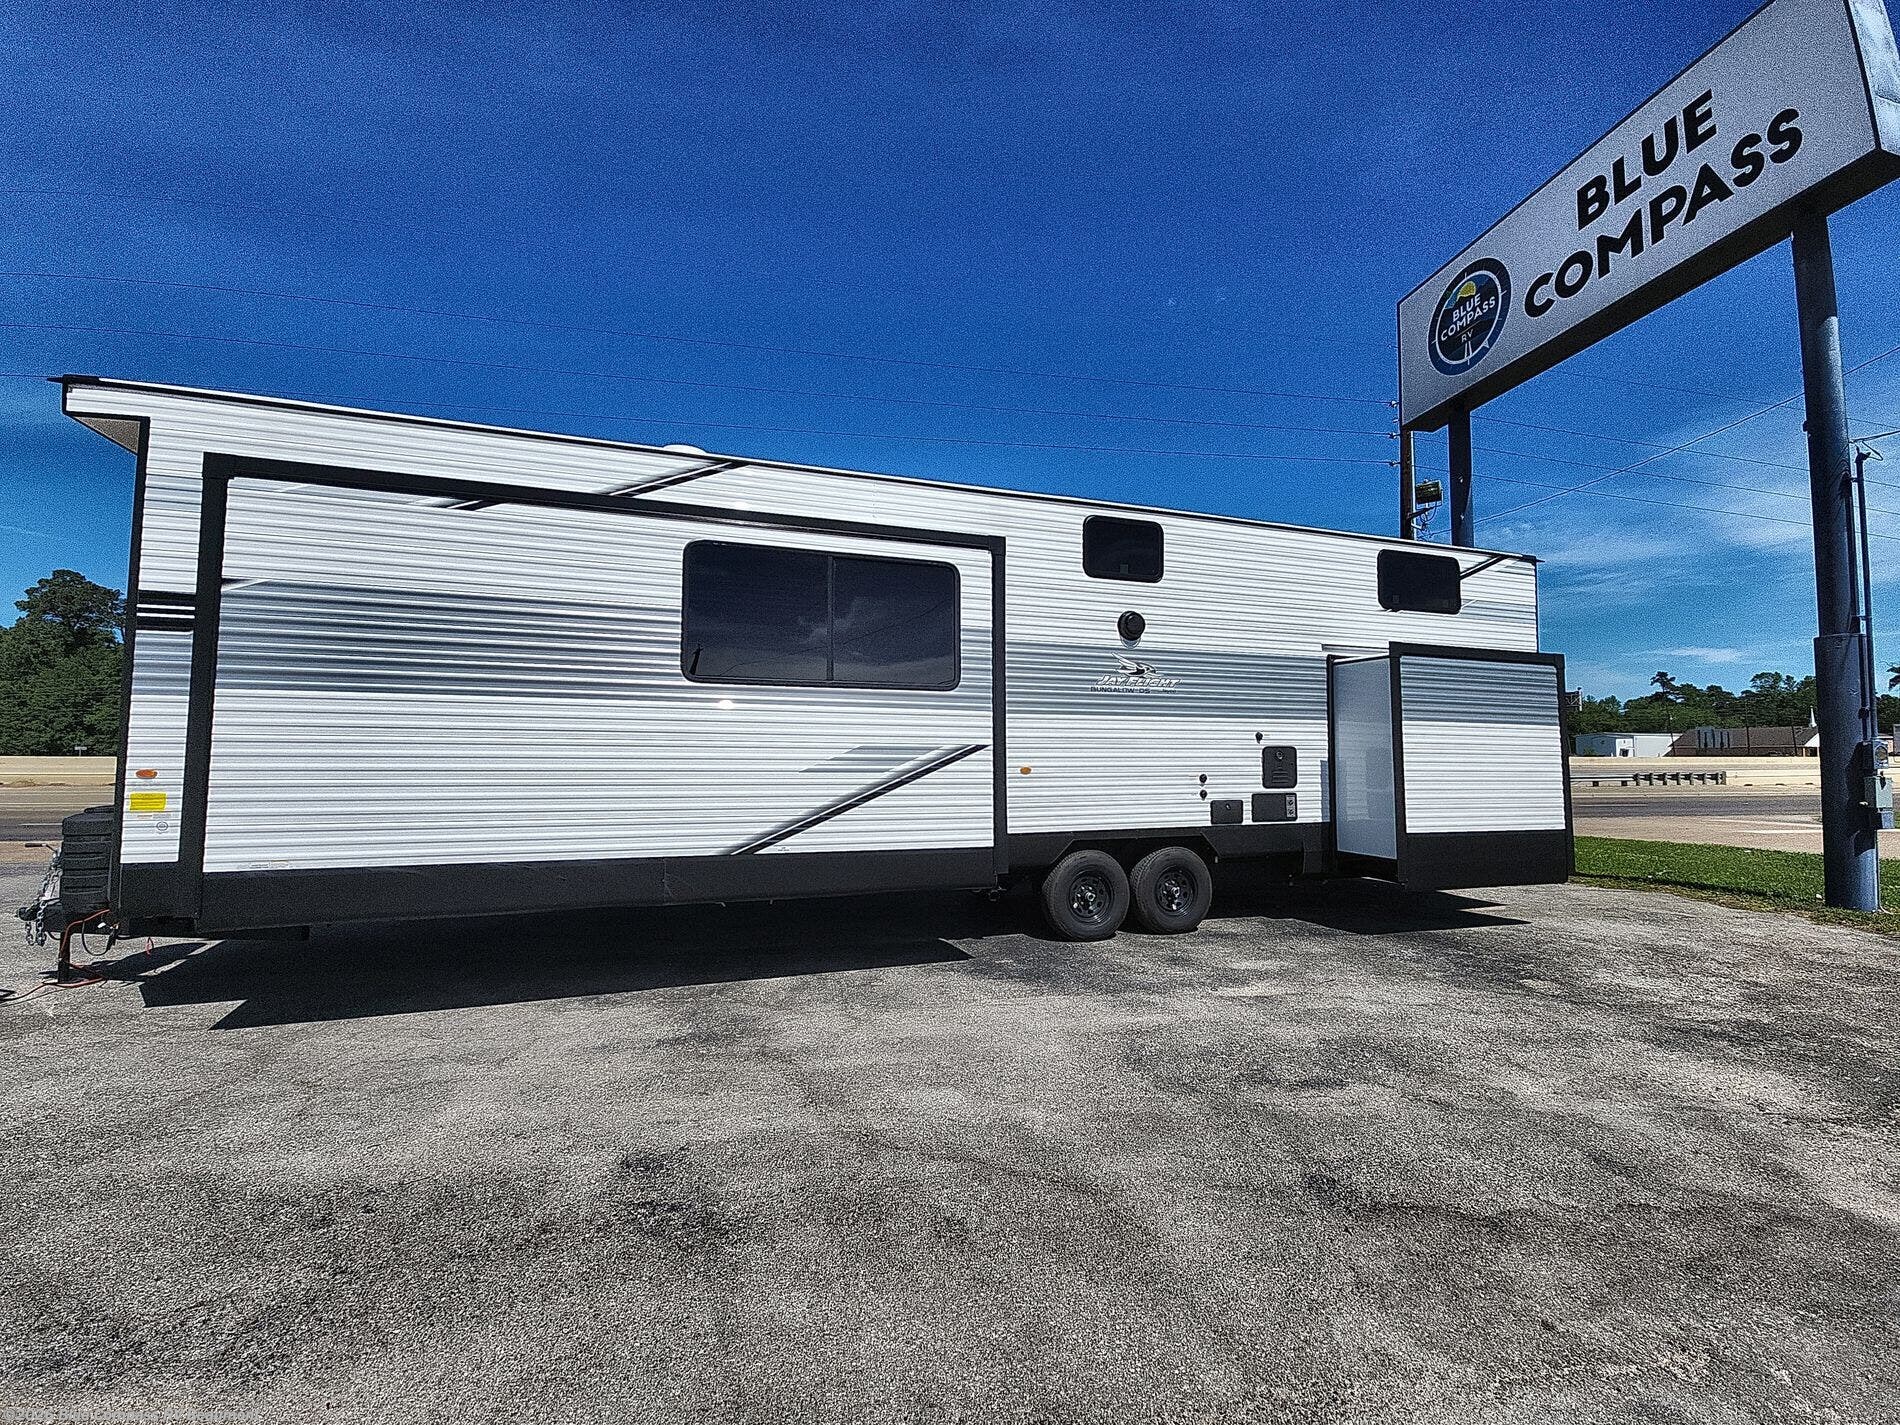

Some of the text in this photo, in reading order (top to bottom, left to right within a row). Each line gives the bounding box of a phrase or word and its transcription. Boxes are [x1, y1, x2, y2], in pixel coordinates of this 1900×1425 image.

[1576, 89, 1719, 231] BLUE
[1524, 108, 1803, 319] COMPASS
[1440, 296, 1496, 341] COMPASS
[1452, 293, 1481, 322] BLUE
[1461, 329, 1474, 342] RV
